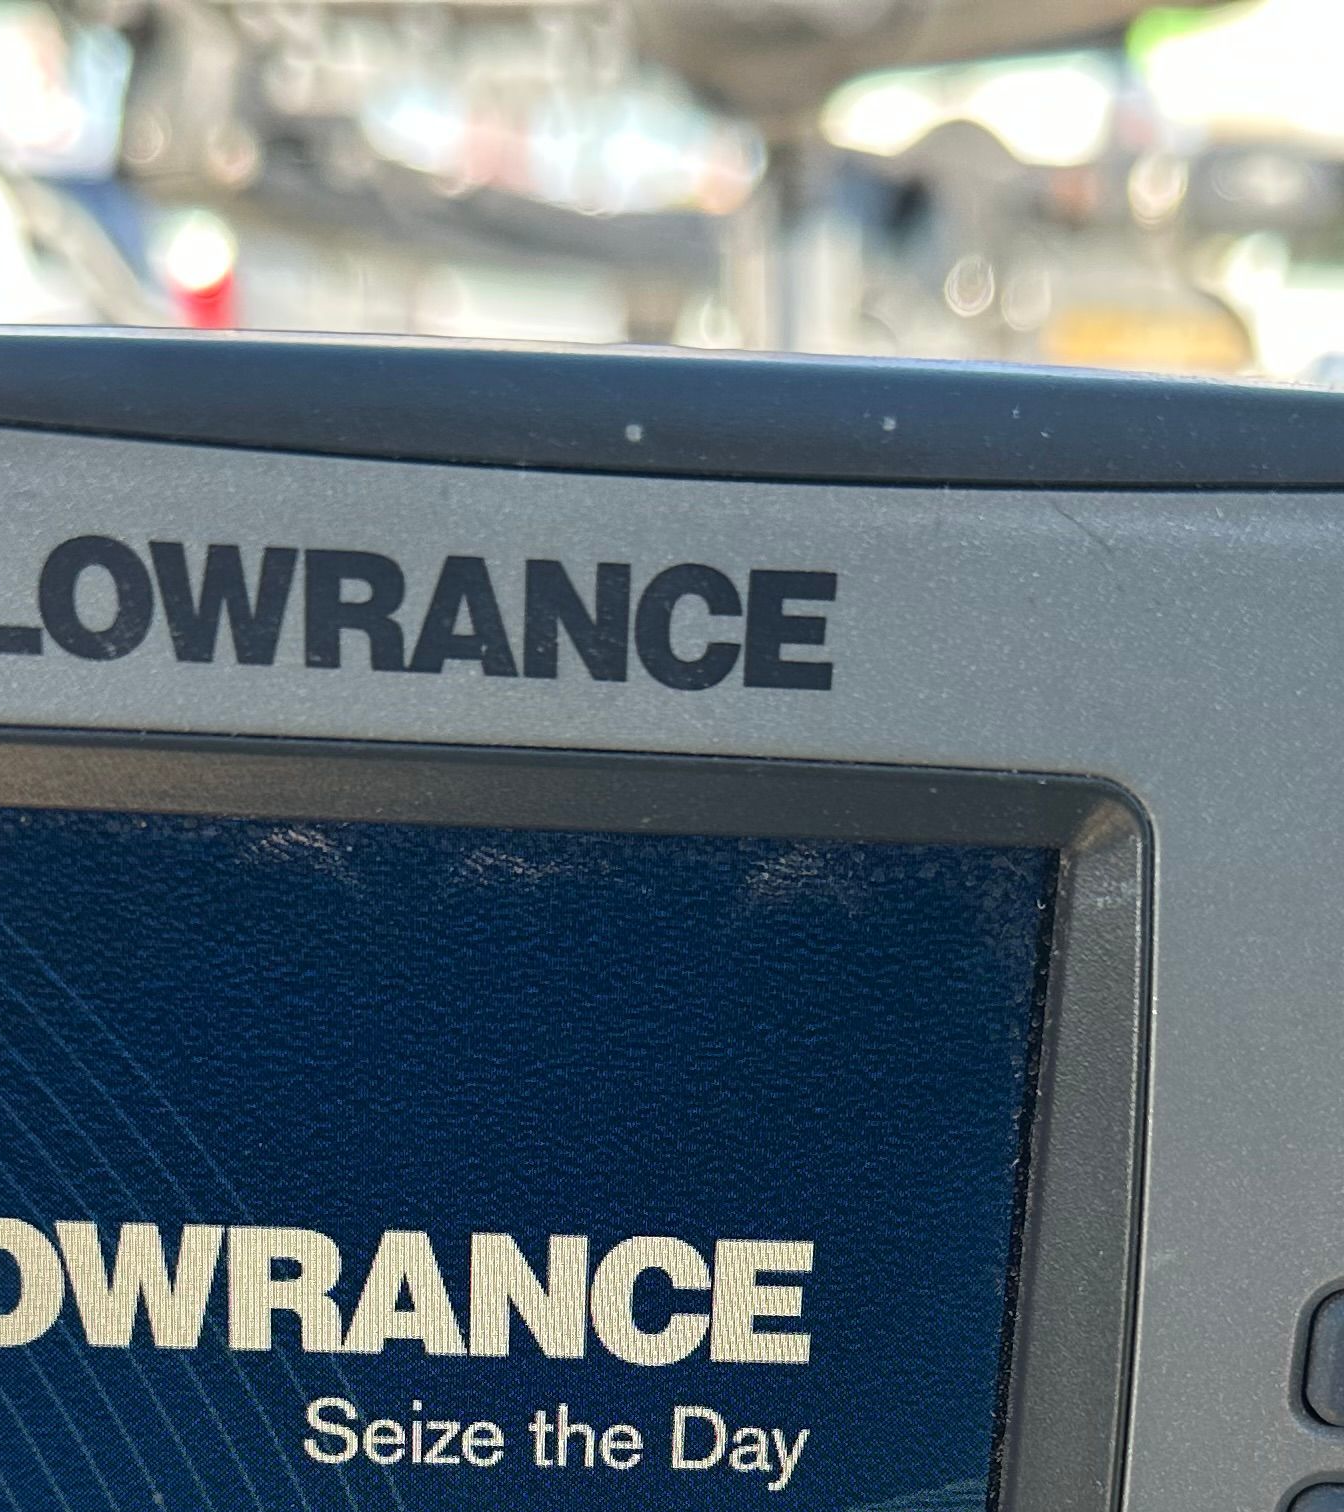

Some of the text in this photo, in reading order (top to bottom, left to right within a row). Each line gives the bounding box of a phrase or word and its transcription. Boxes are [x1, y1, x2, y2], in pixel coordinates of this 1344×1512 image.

[302, 1398, 809, 1489] Seize the Day
